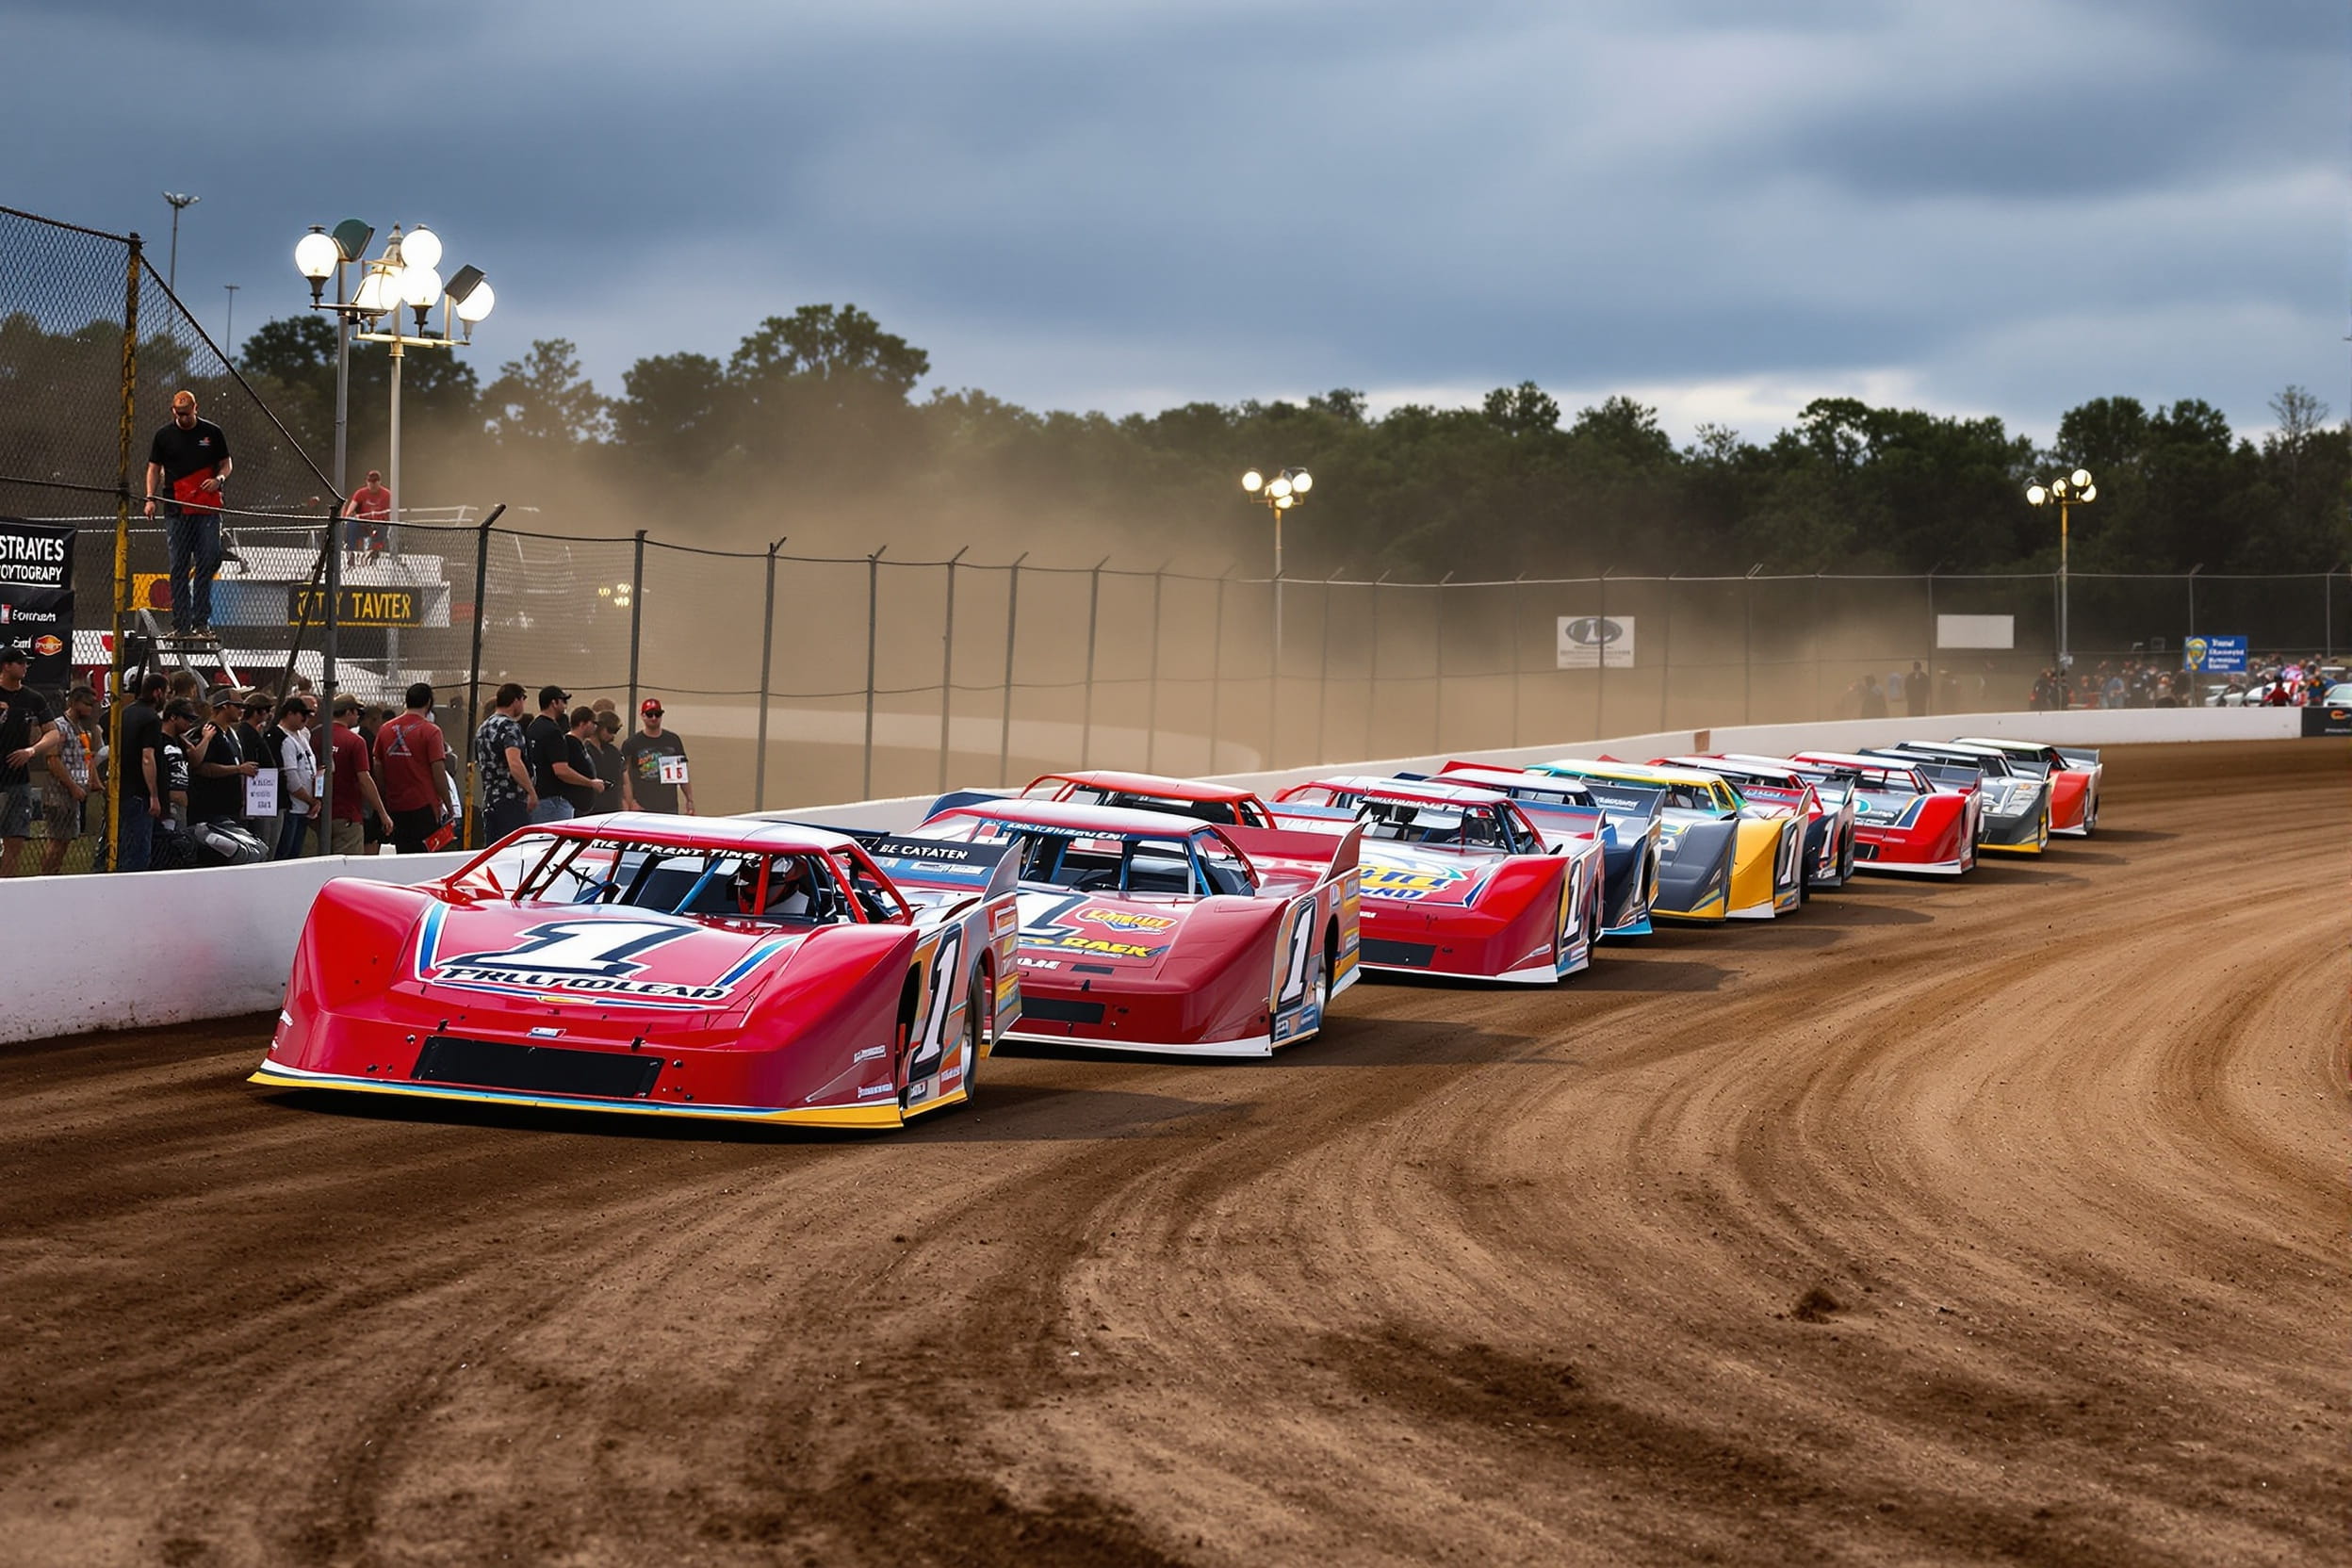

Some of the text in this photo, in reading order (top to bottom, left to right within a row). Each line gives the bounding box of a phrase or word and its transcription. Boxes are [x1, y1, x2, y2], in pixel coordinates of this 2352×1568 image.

[0, 535, 65, 562] STRAYES
[0, 564, 63, 580] OYTOGRAPY
[1561, 859, 1583, 944] 1
[435, 920, 703, 976] 1
[1278, 900, 1315, 1009] 1
[910, 927, 960, 1079] 1
